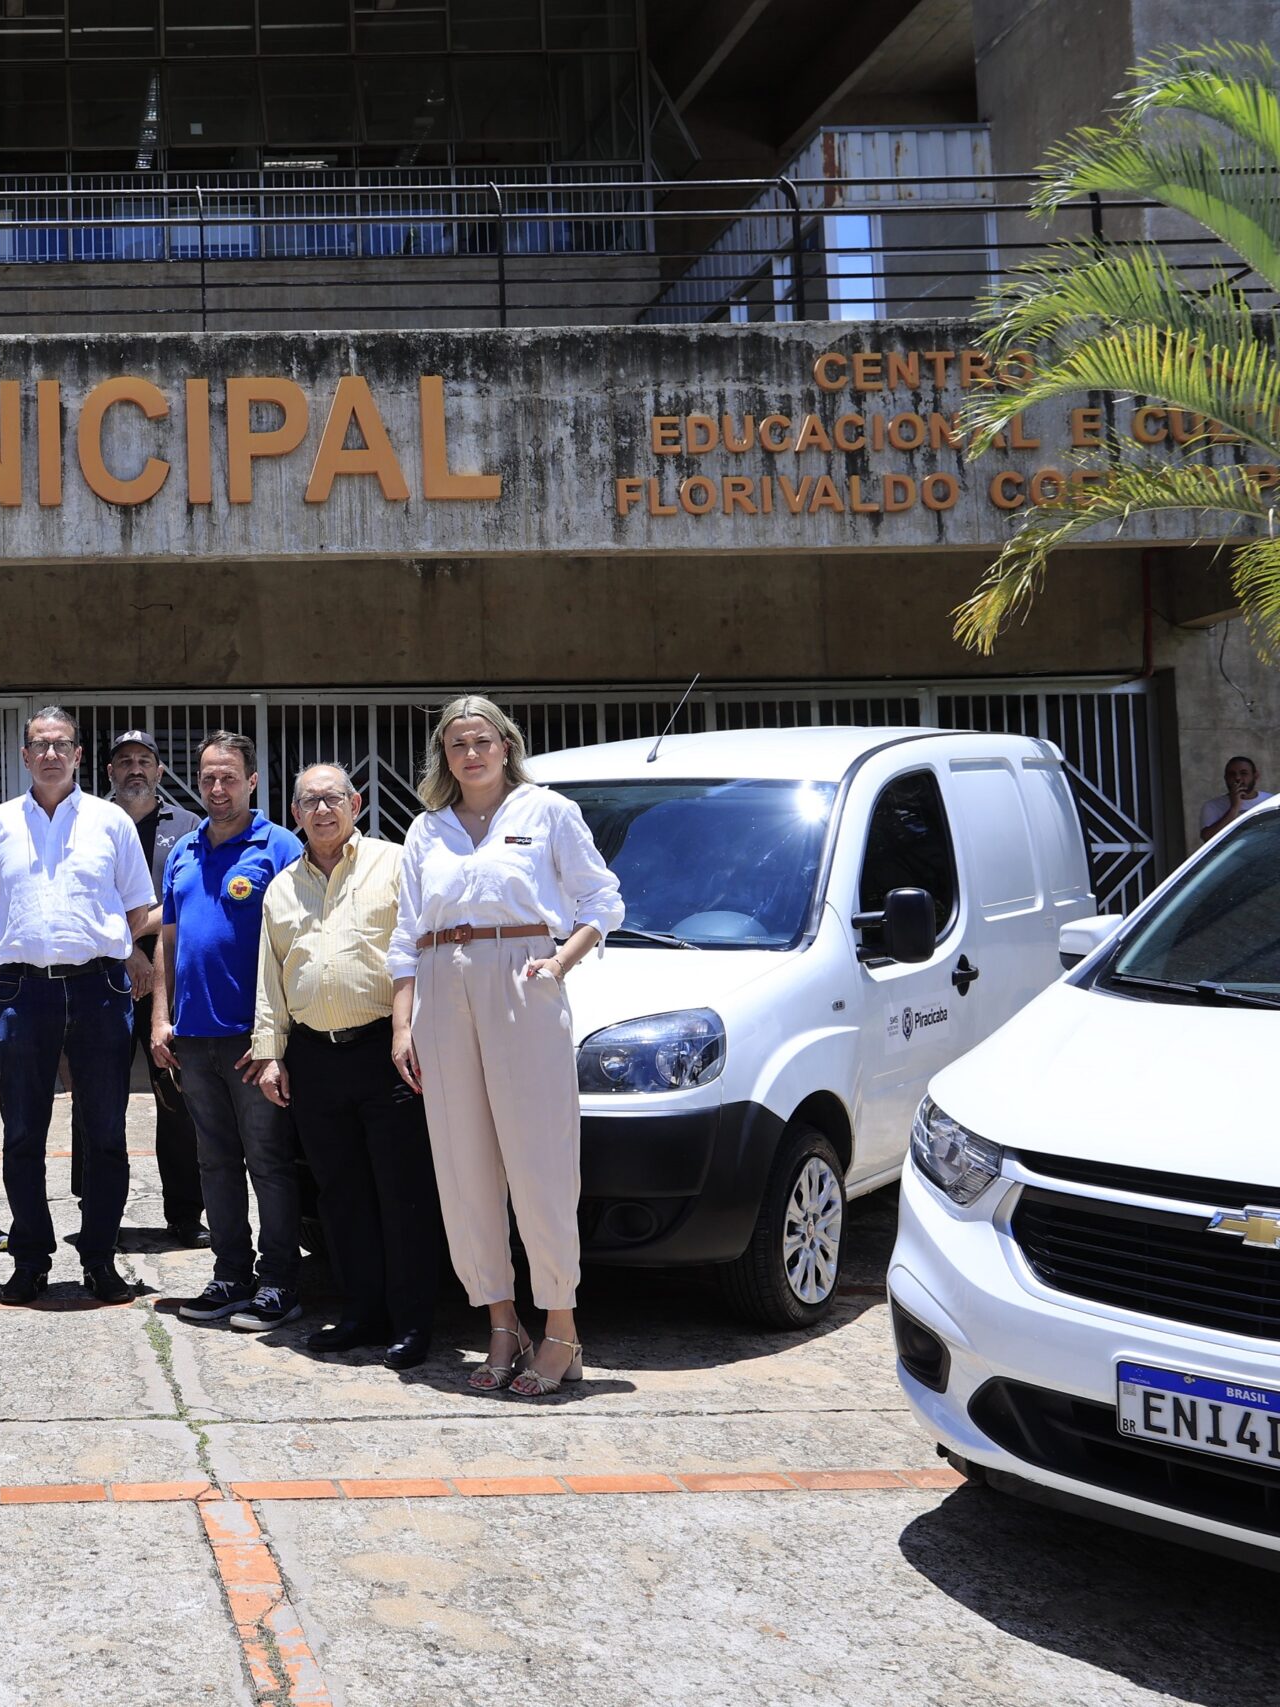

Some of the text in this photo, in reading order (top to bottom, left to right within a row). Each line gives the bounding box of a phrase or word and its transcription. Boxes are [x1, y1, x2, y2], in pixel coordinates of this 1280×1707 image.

[814, 349, 1035, 391] CENTRO
[1072, 407, 1102, 446] E
[616, 471, 959, 517] FLORIVALDO
[915, 1006, 948, 1029] Piracicaba
[1226, 1386, 1270, 1405] BRASIL
[1122, 1418, 1136, 1433] BR
